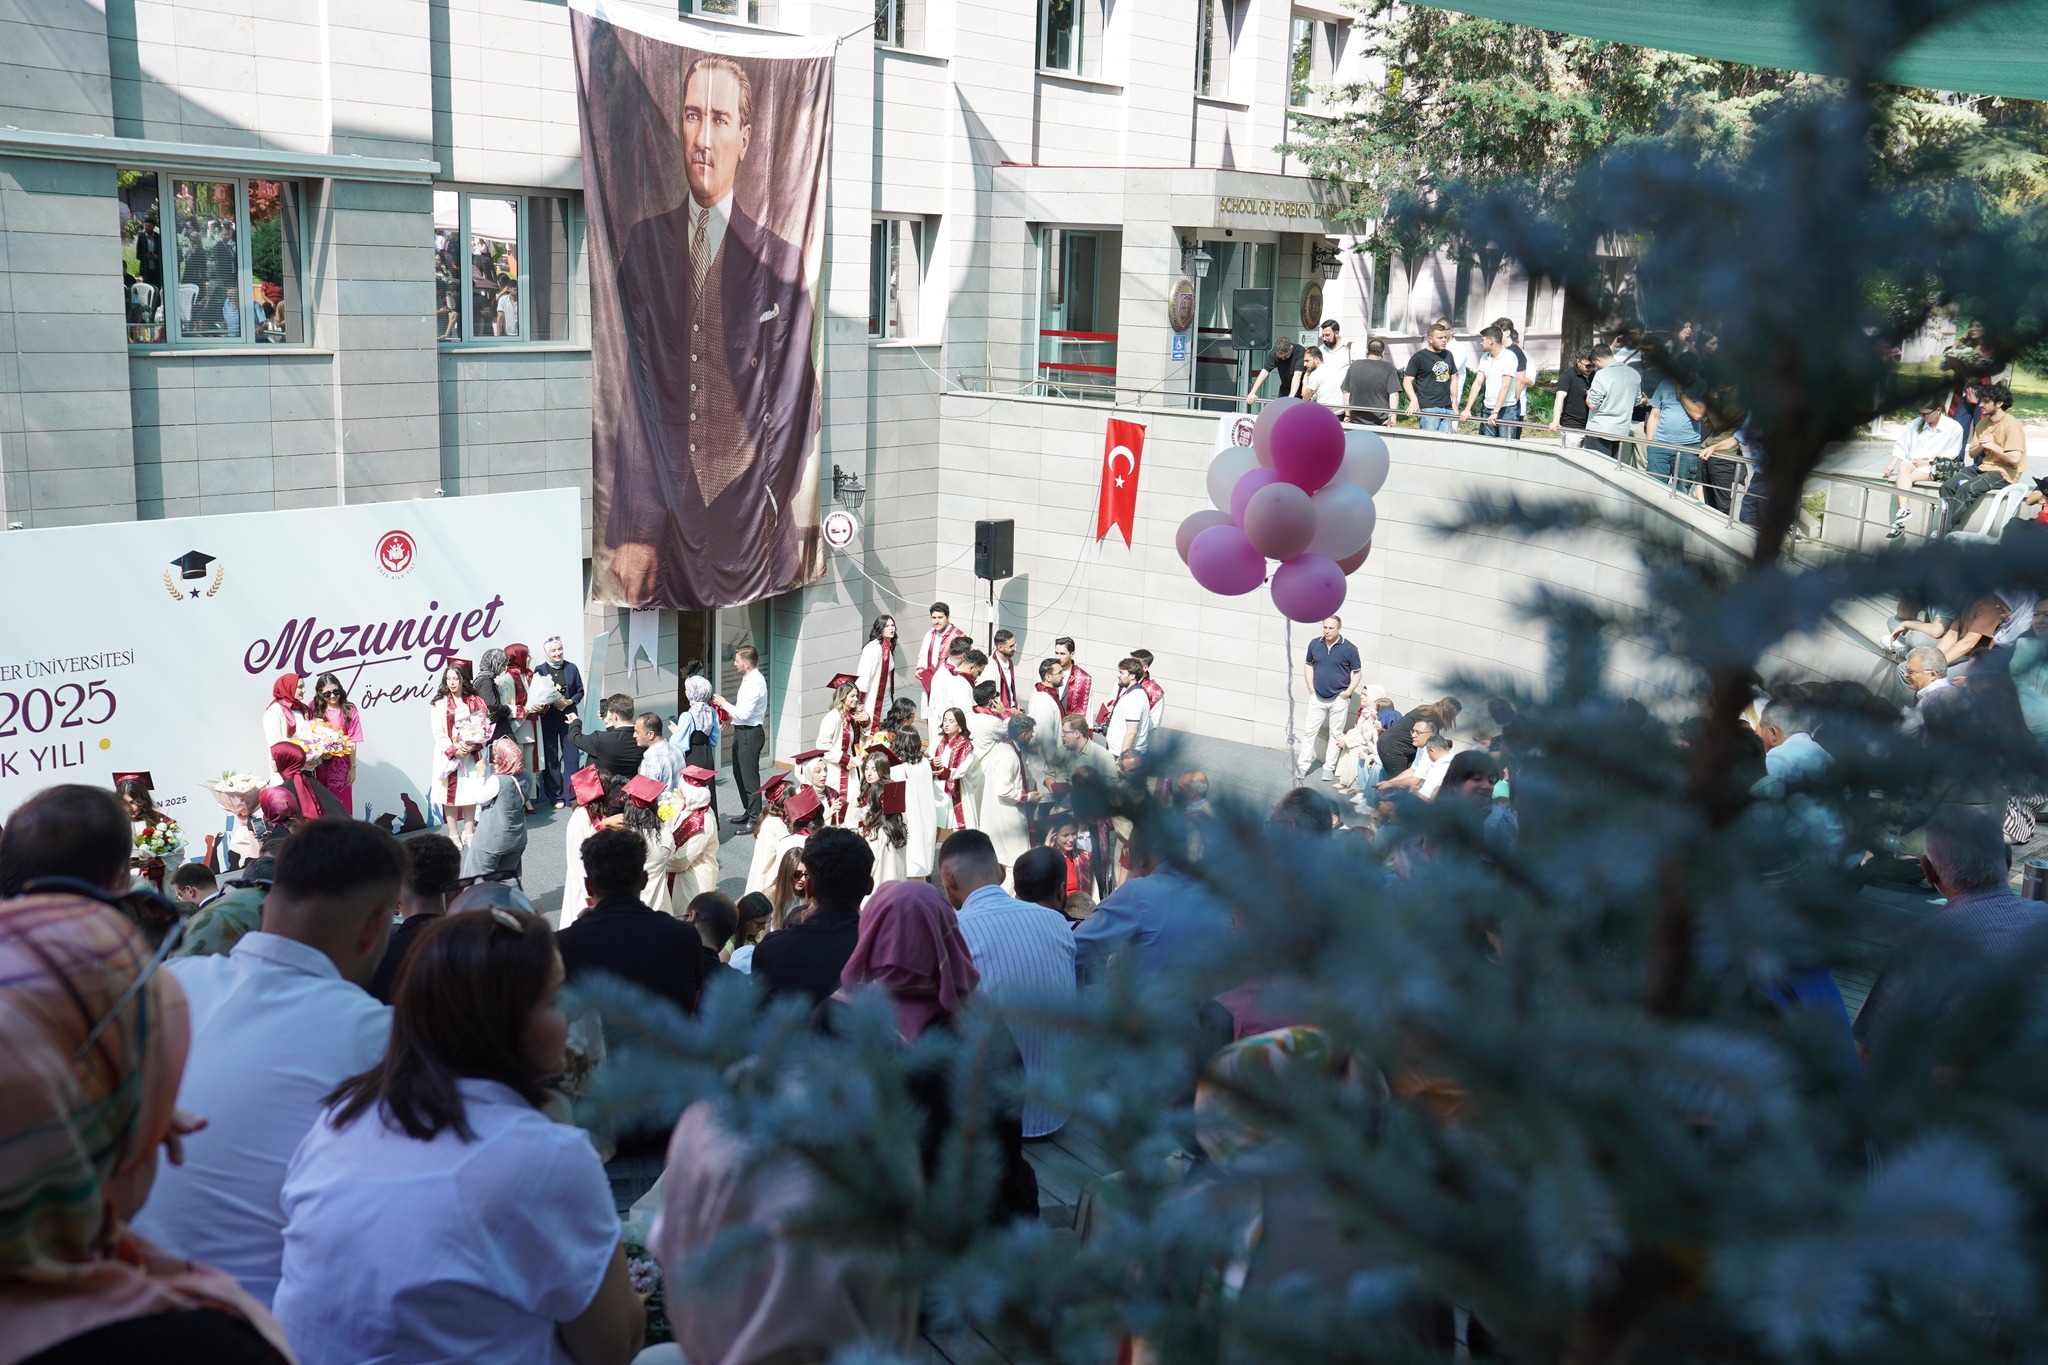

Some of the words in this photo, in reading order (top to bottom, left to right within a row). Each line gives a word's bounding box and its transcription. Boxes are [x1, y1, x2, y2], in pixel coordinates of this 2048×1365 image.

[1219, 197, 1258, 215] SCHOOL
[1259, 200, 1271, 215] OF
[1273, 201, 1312, 219] FOREIGN
[243, 594, 505, 678] Mezuniyet
[25, 648, 135, 679] ÜNİVERSİTESİ
[315, 655, 434, 710] Töreni
[0, 679, 117, 738] 2025
[29, 741, 84, 772] YILI
[165, 796, 188, 807] 2025
